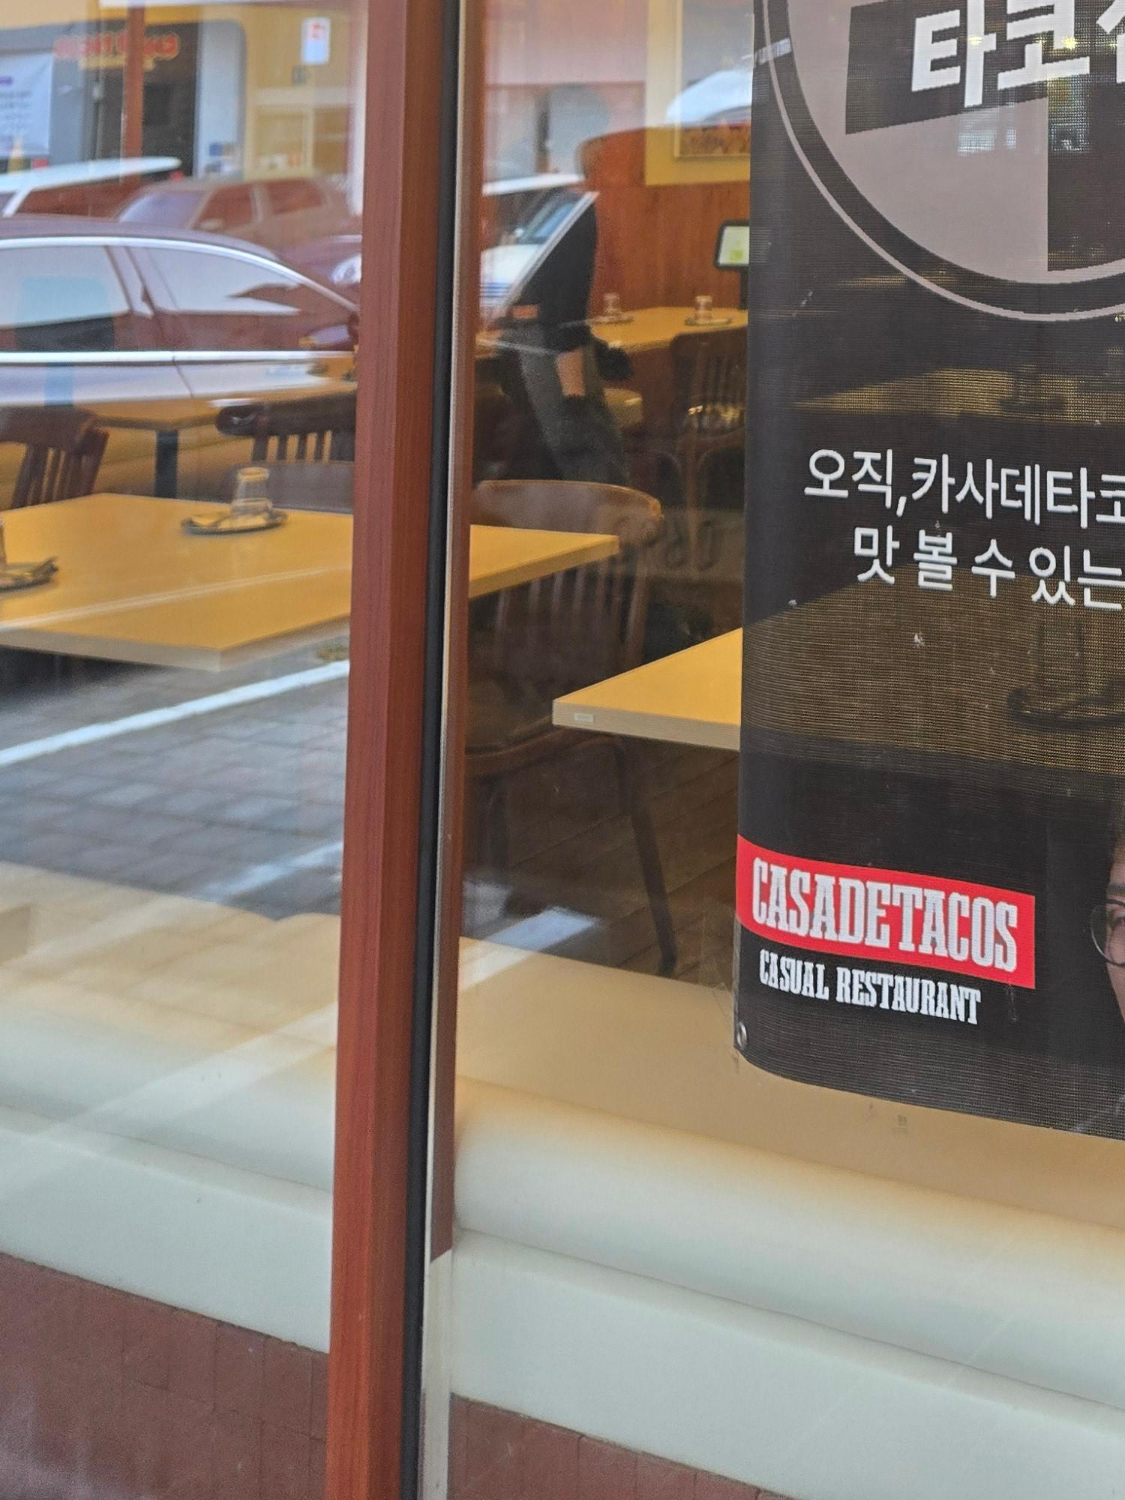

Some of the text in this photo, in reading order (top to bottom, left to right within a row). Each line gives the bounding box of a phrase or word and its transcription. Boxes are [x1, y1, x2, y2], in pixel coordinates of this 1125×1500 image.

[853, 525, 900, 585] 맛
[912, 528, 959, 589] 볼
[971, 538, 1016, 597] 수
[752, 857, 1019, 973] CASADETACOS
[759, 949, 982, 1026] CASUAL RESTAURANT
